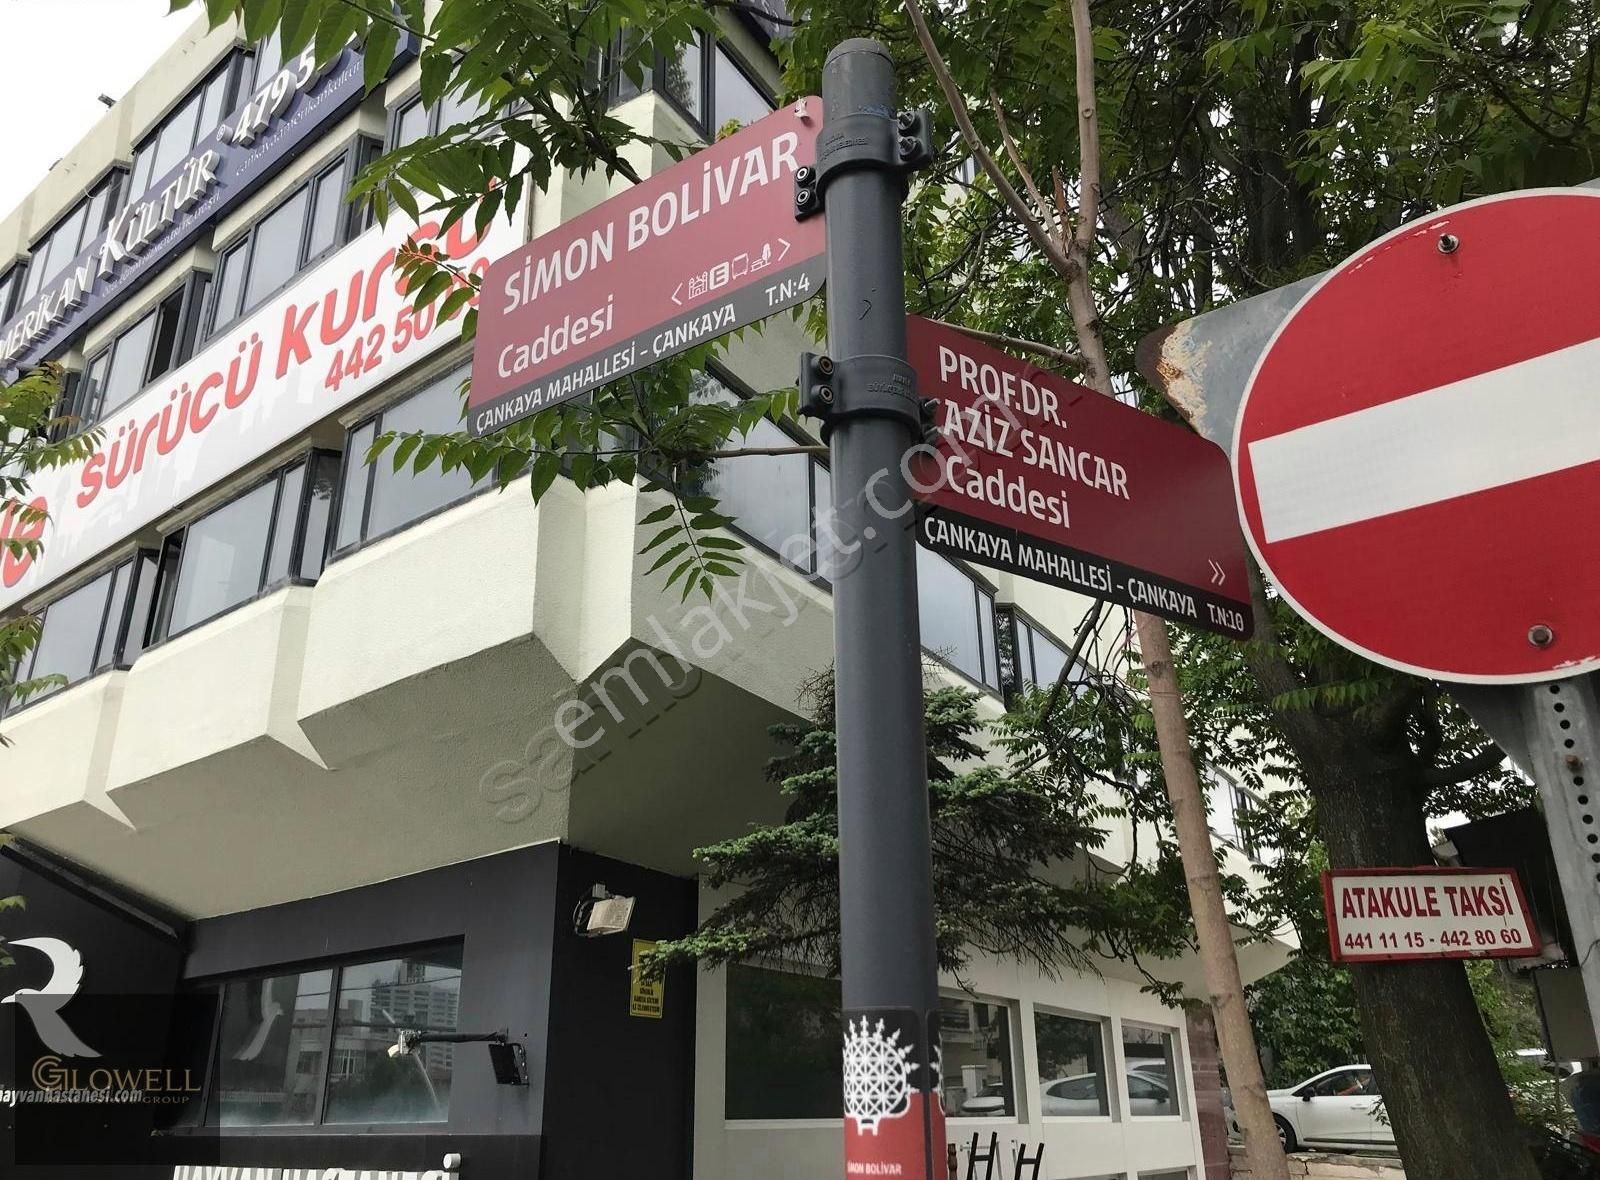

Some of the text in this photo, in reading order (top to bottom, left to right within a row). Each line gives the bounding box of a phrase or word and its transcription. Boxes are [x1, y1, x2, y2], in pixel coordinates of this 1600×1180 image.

[503, 221, 615, 315] SİMON
[627, 130, 799, 252] BOLİVAR
[765, 272, 811, 307] T.N:4
[324, 296, 436, 391] 442 50
[476, 387, 542, 435] ÇANKAYA
[546, 341, 636, 402] MAHALLESİ
[652, 302, 736, 358] ÇANKAYA
[498, 294, 614, 379] Caddesi
[76, 332, 263, 508] sürücü
[939, 345, 1068, 429] PROF.DR.
[942, 398, 1130, 500] AZİZ SANCAR
[946, 455, 1070, 528] Caddesi
[924, 516, 1013, 564] ÇANKAYA
[1018, 543, 1113, 593] MAHALLESİ
[1128, 577, 1197, 618] ÇANKAYA
[1207, 602, 1245, 632] T.N:10
[1342, 878, 1514, 919] ATAKULE TAKSİ
[1344, 932, 1373, 950] 441
[1379, 932, 1398, 949] 11
[1404, 931, 1425, 948] 15
[1440, 930, 1471, 947] 442
[1475, 929, 1496, 946] 80
[1500, 928, 1522, 945] 60
[0, 1085, 145, 1107] ayvanhastanesi.com
